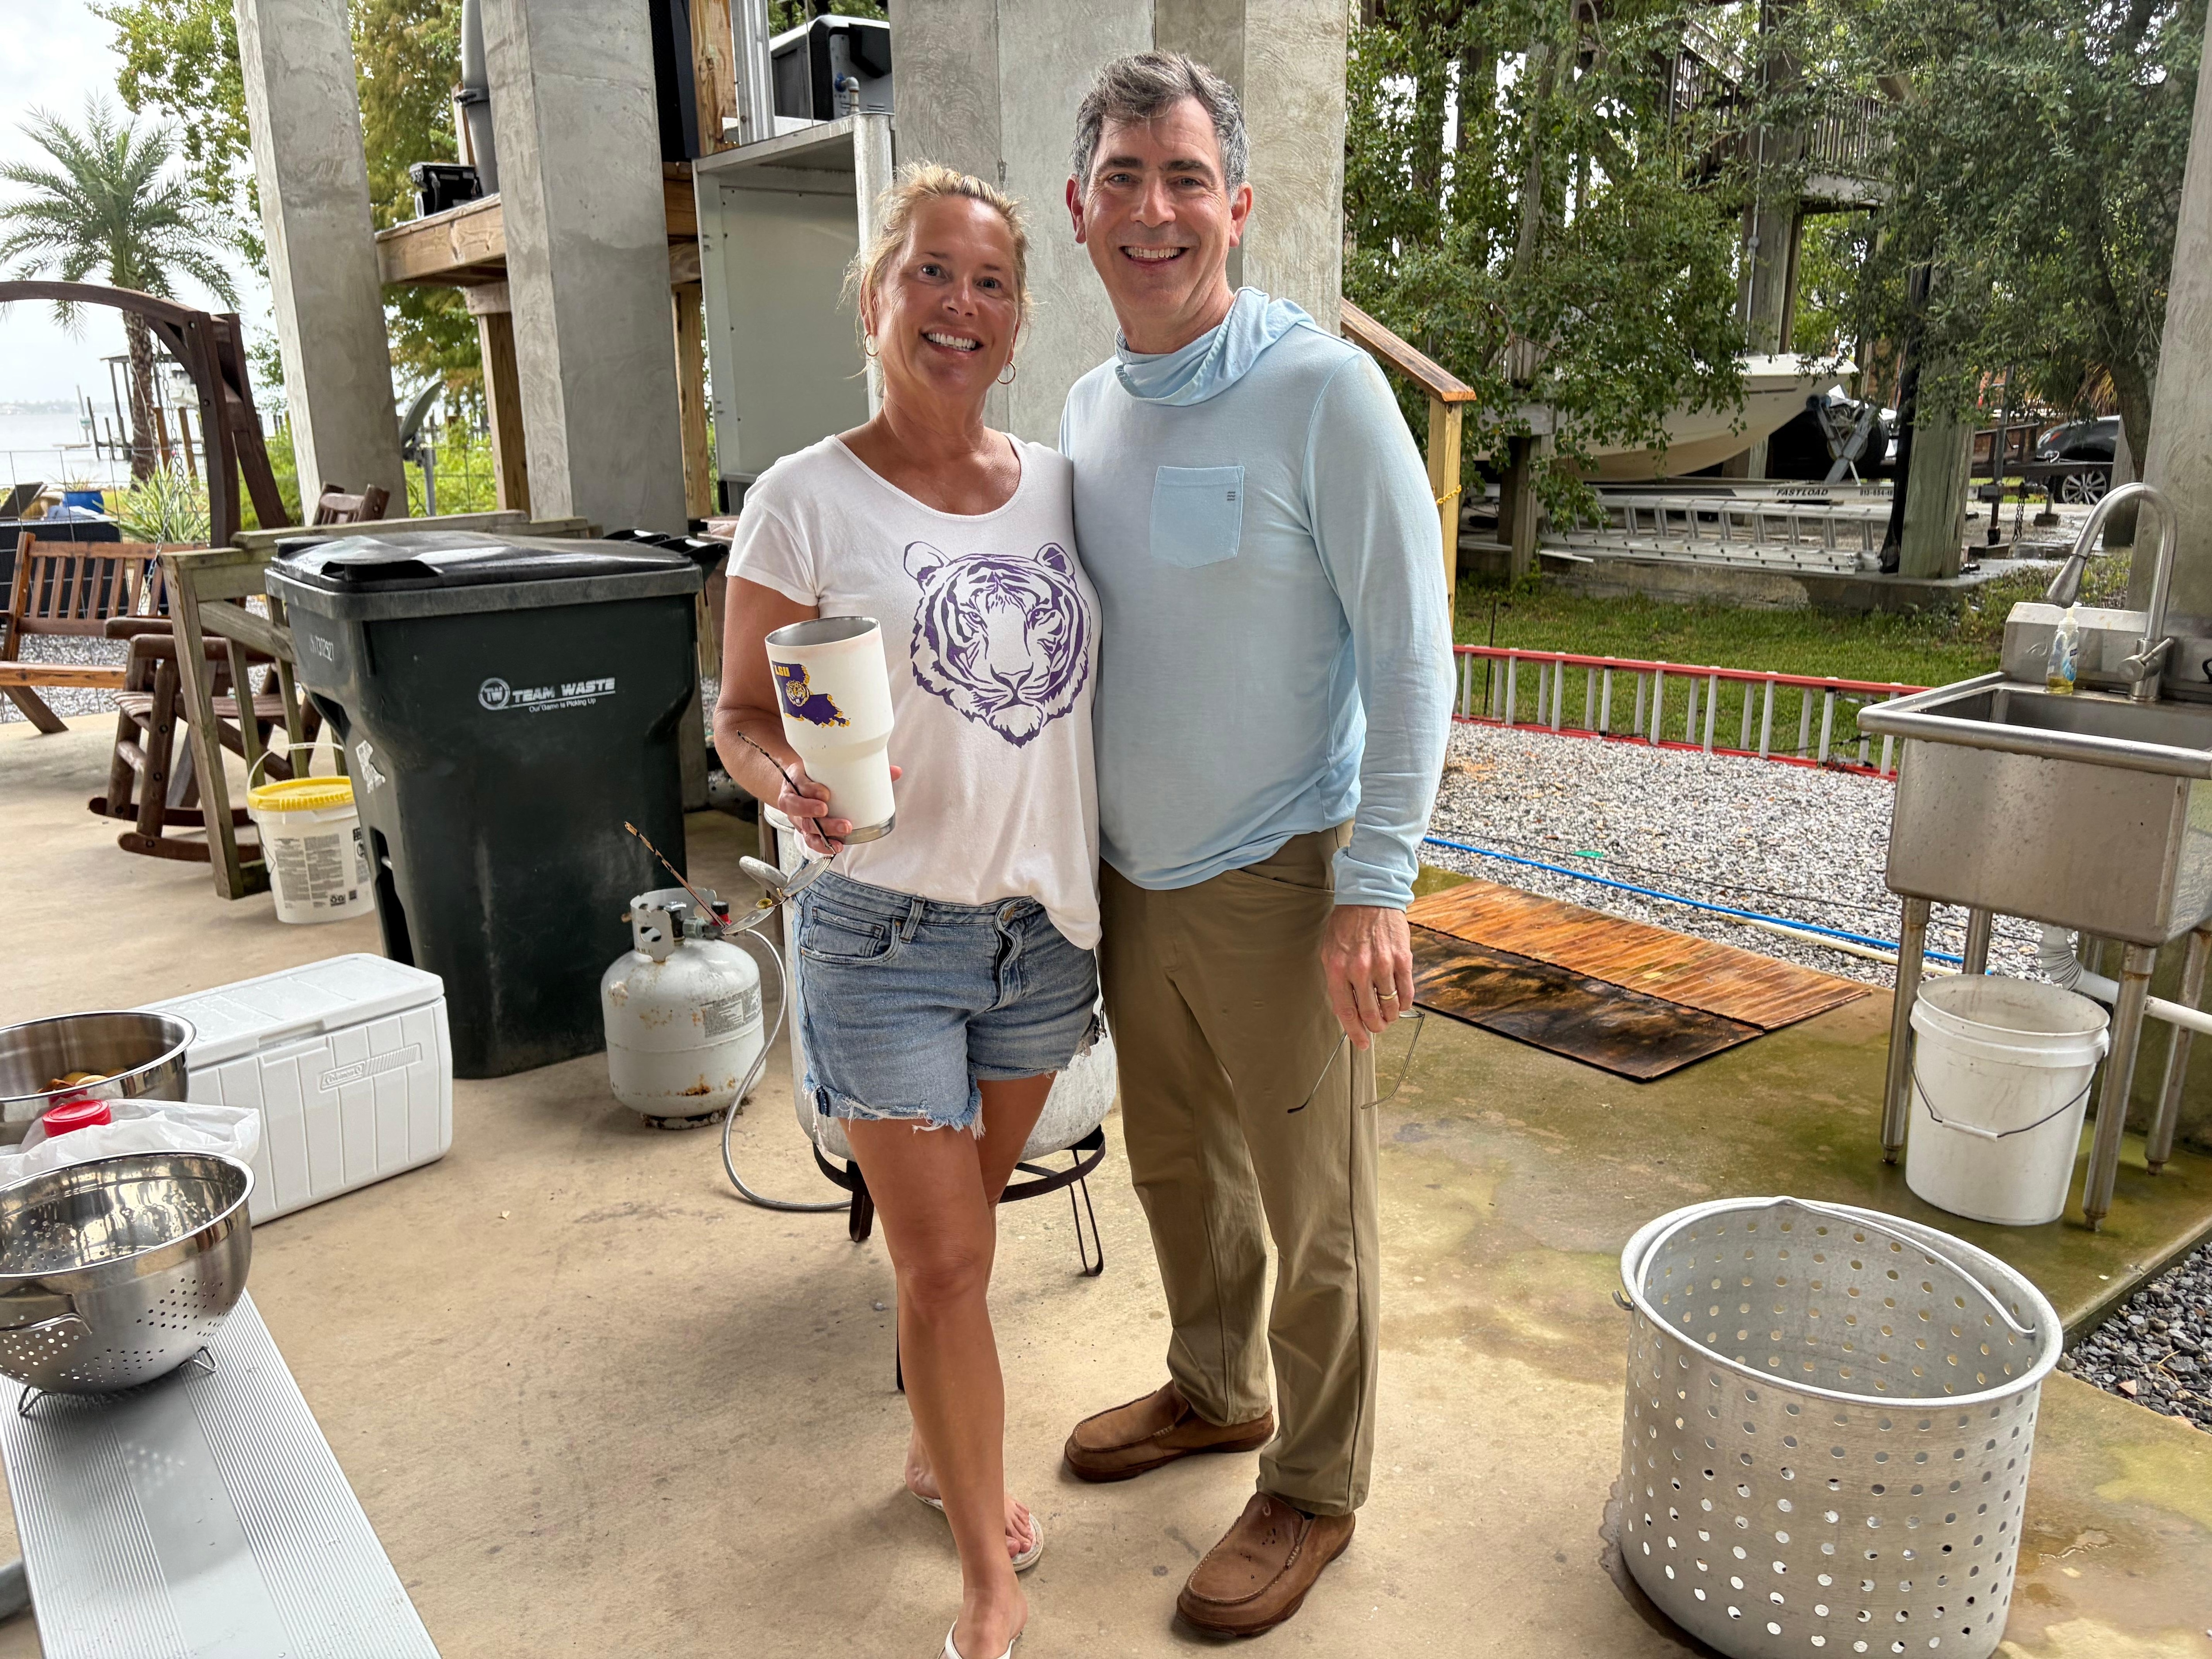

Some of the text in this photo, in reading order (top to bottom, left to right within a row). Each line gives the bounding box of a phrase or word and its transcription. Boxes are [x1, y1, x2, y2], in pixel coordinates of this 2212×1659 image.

[774, 664, 791, 677] LSU
[484, 686, 503, 702] TW
[512, 677, 615, 703] TEAM WASTE
[566, 699, 587, 707] Picking
